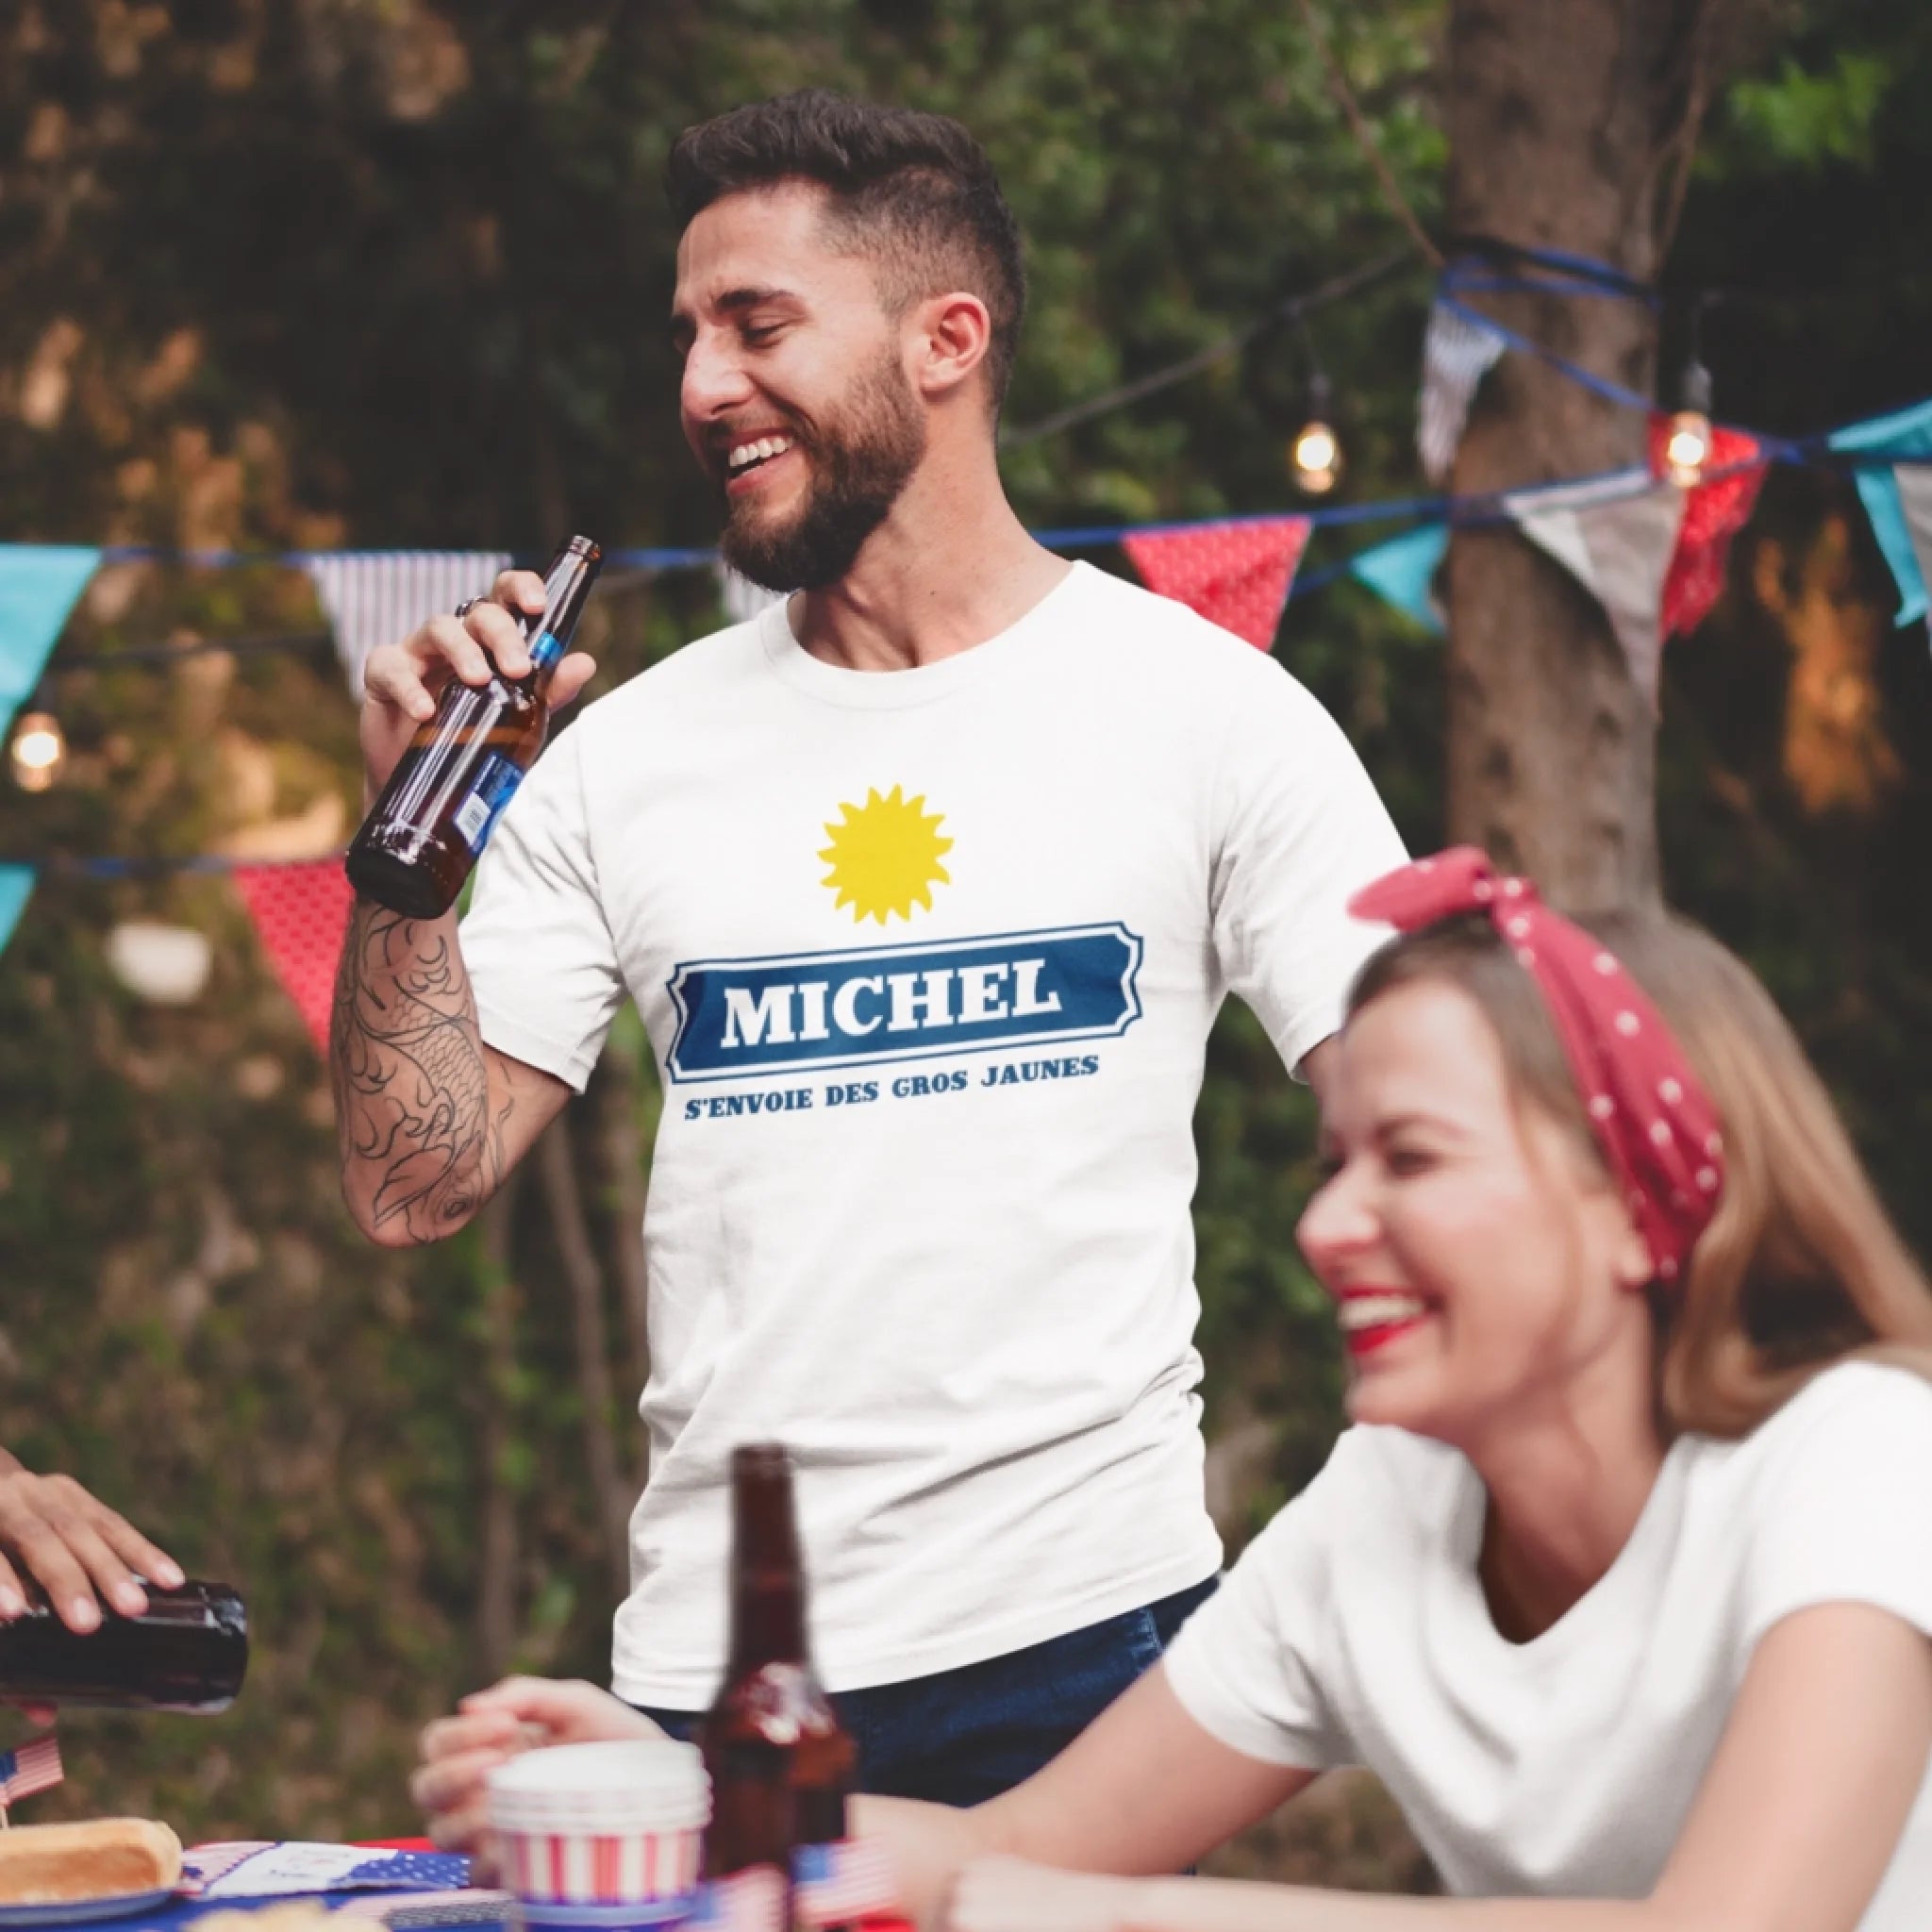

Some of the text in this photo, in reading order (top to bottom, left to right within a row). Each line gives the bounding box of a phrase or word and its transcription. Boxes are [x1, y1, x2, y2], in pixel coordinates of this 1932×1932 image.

[721, 958, 1061, 1048] MICHEL
[685, 1055, 1099, 1120] S'ENVOIE DES GROS JAUNES
